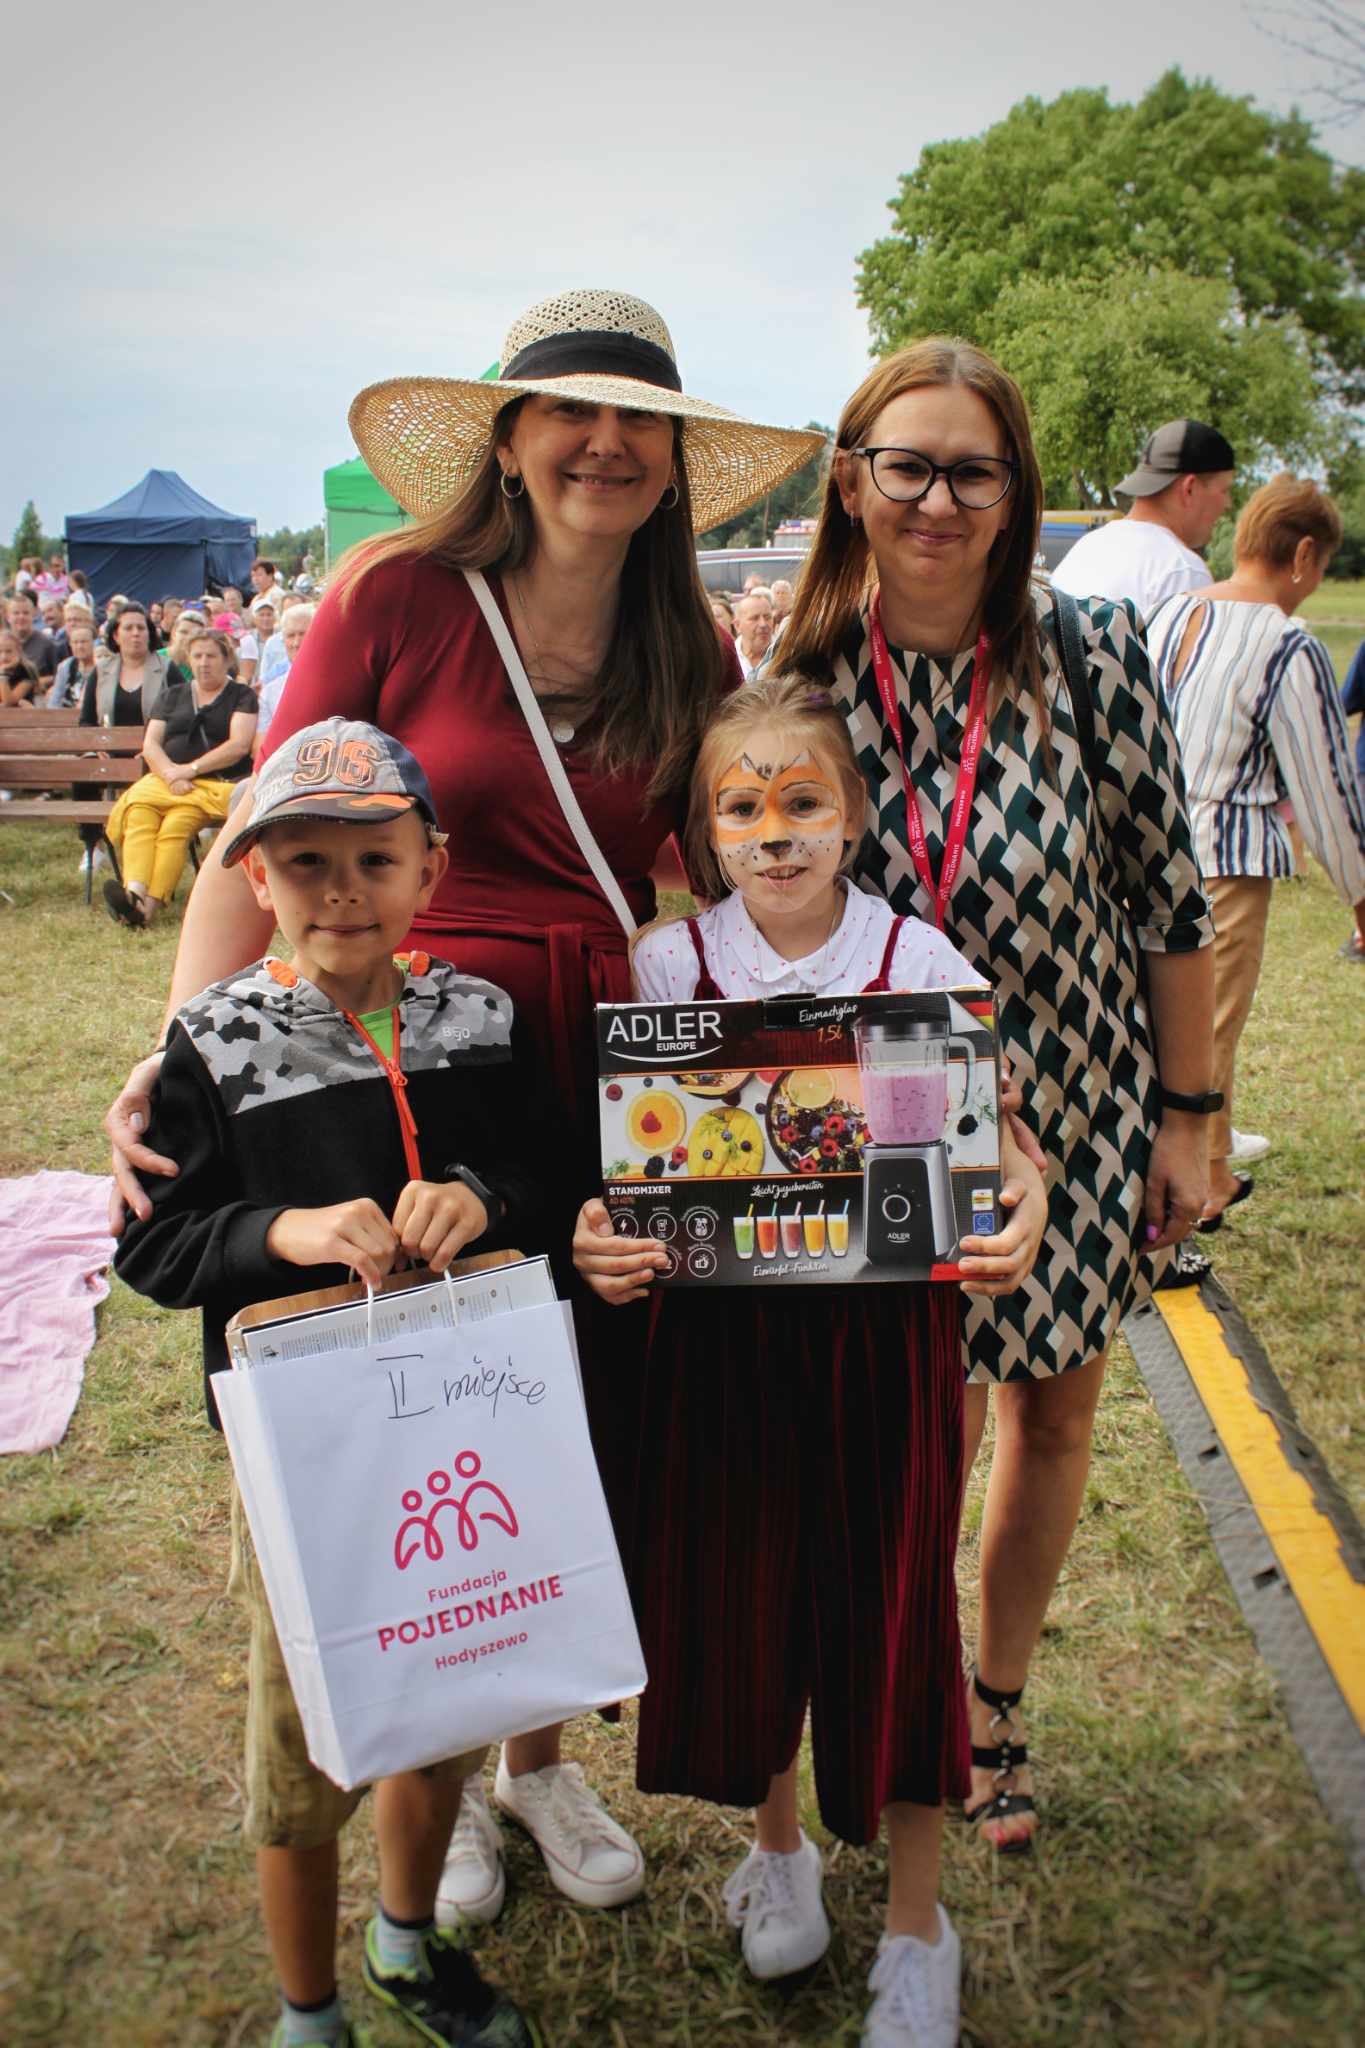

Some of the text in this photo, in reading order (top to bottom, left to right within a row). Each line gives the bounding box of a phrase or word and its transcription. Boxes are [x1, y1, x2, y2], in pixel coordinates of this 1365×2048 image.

[292, 738, 380, 788] 96
[606, 1011, 724, 1043] ADLER
[799, 1002, 857, 1022] Einmachglas
[656, 1041, 697, 1051] EUROPE
[609, 1186, 672, 1195] STANDMIXER
[887, 1232, 911, 1240] ADLER
[428, 1569, 507, 1602] Fundacja
[378, 1575, 564, 1651] POJEDNANIE
[435, 1631, 529, 1670] Hodyszewo
